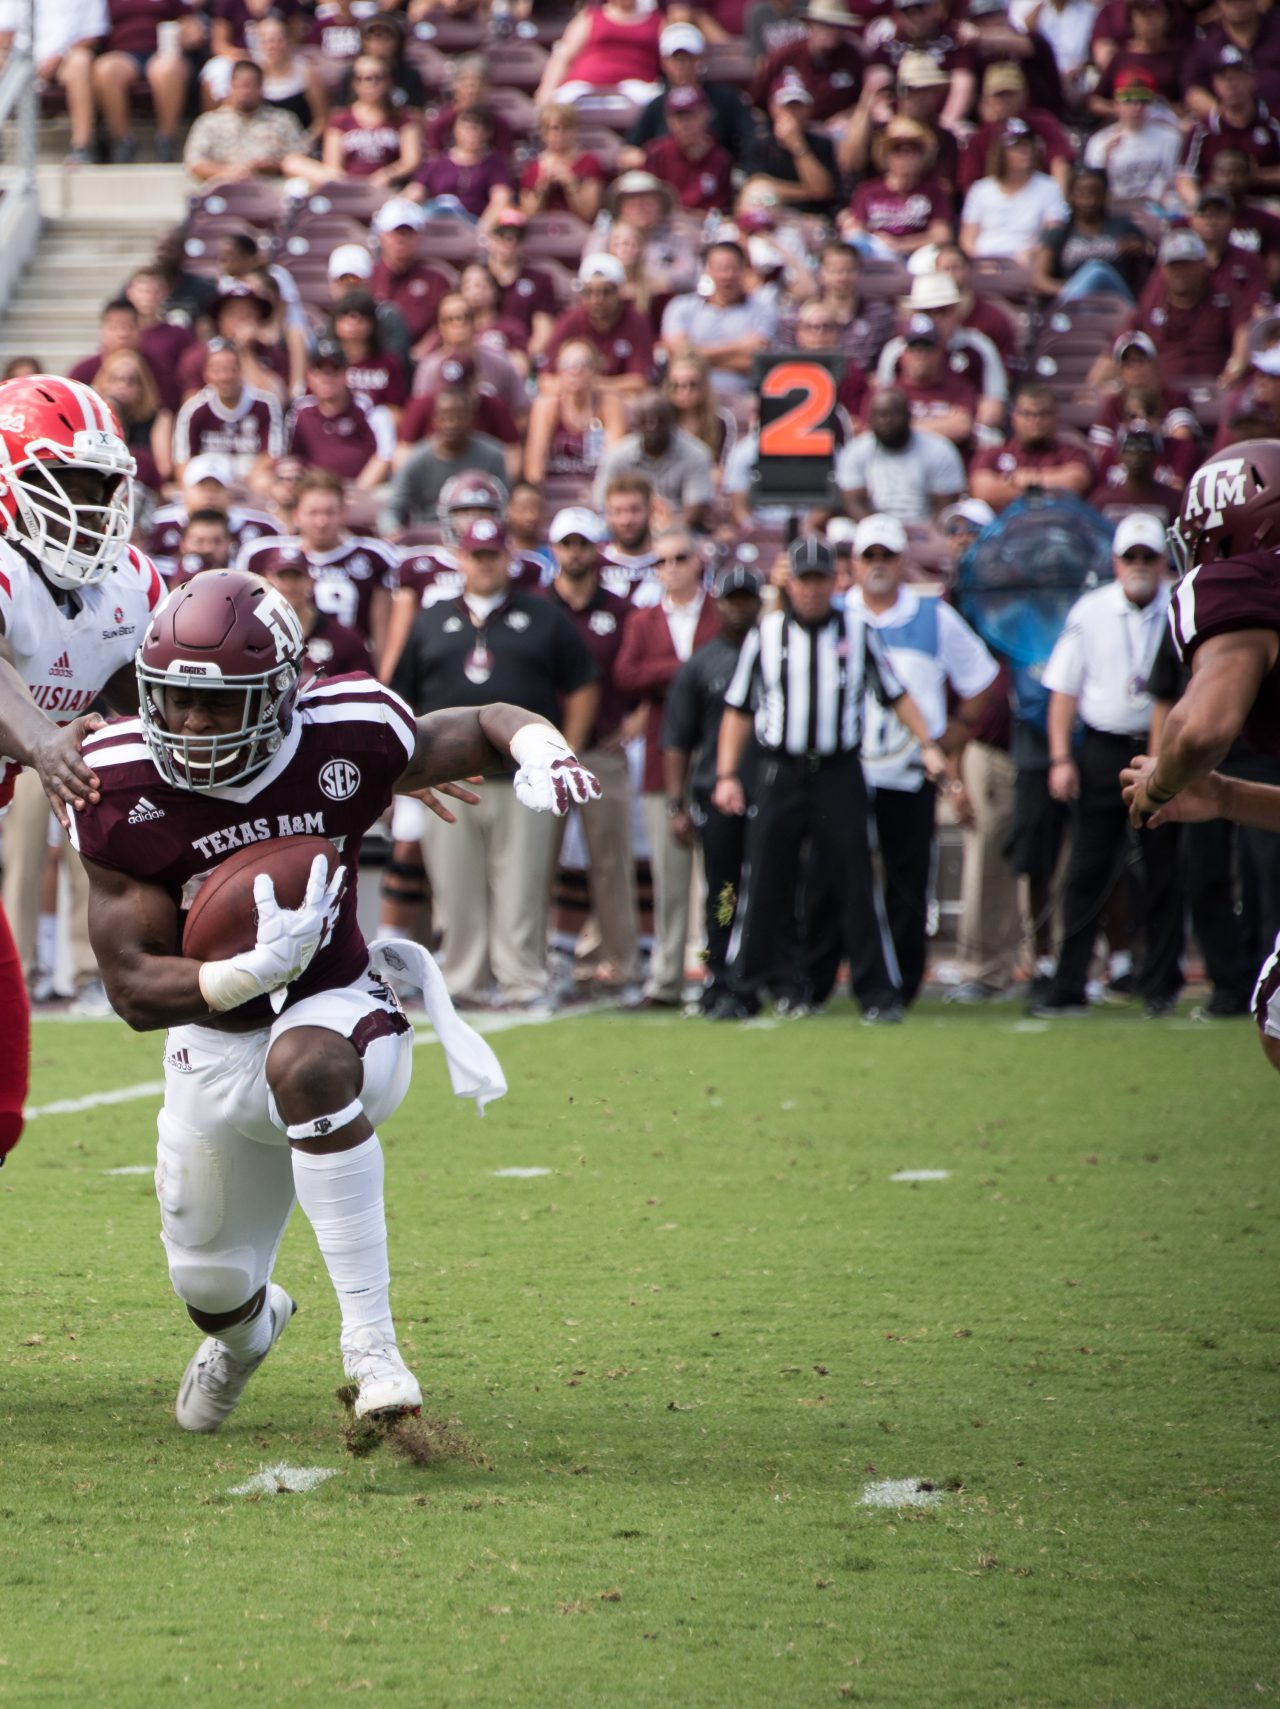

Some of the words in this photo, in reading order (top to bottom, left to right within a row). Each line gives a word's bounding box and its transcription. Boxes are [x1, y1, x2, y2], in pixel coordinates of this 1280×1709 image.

[760, 362, 836, 455] 2
[102, 630, 118, 640] SUN
[119, 626, 136, 636] BELT
[48, 668, 74, 678] adidas
[179, 664, 207, 676] AGGIES
[322, 762, 358, 798] SEC
[127, 808, 166, 825] adidas
[192, 817, 272, 860] TEXAS
[277, 811, 325, 837] A&M
